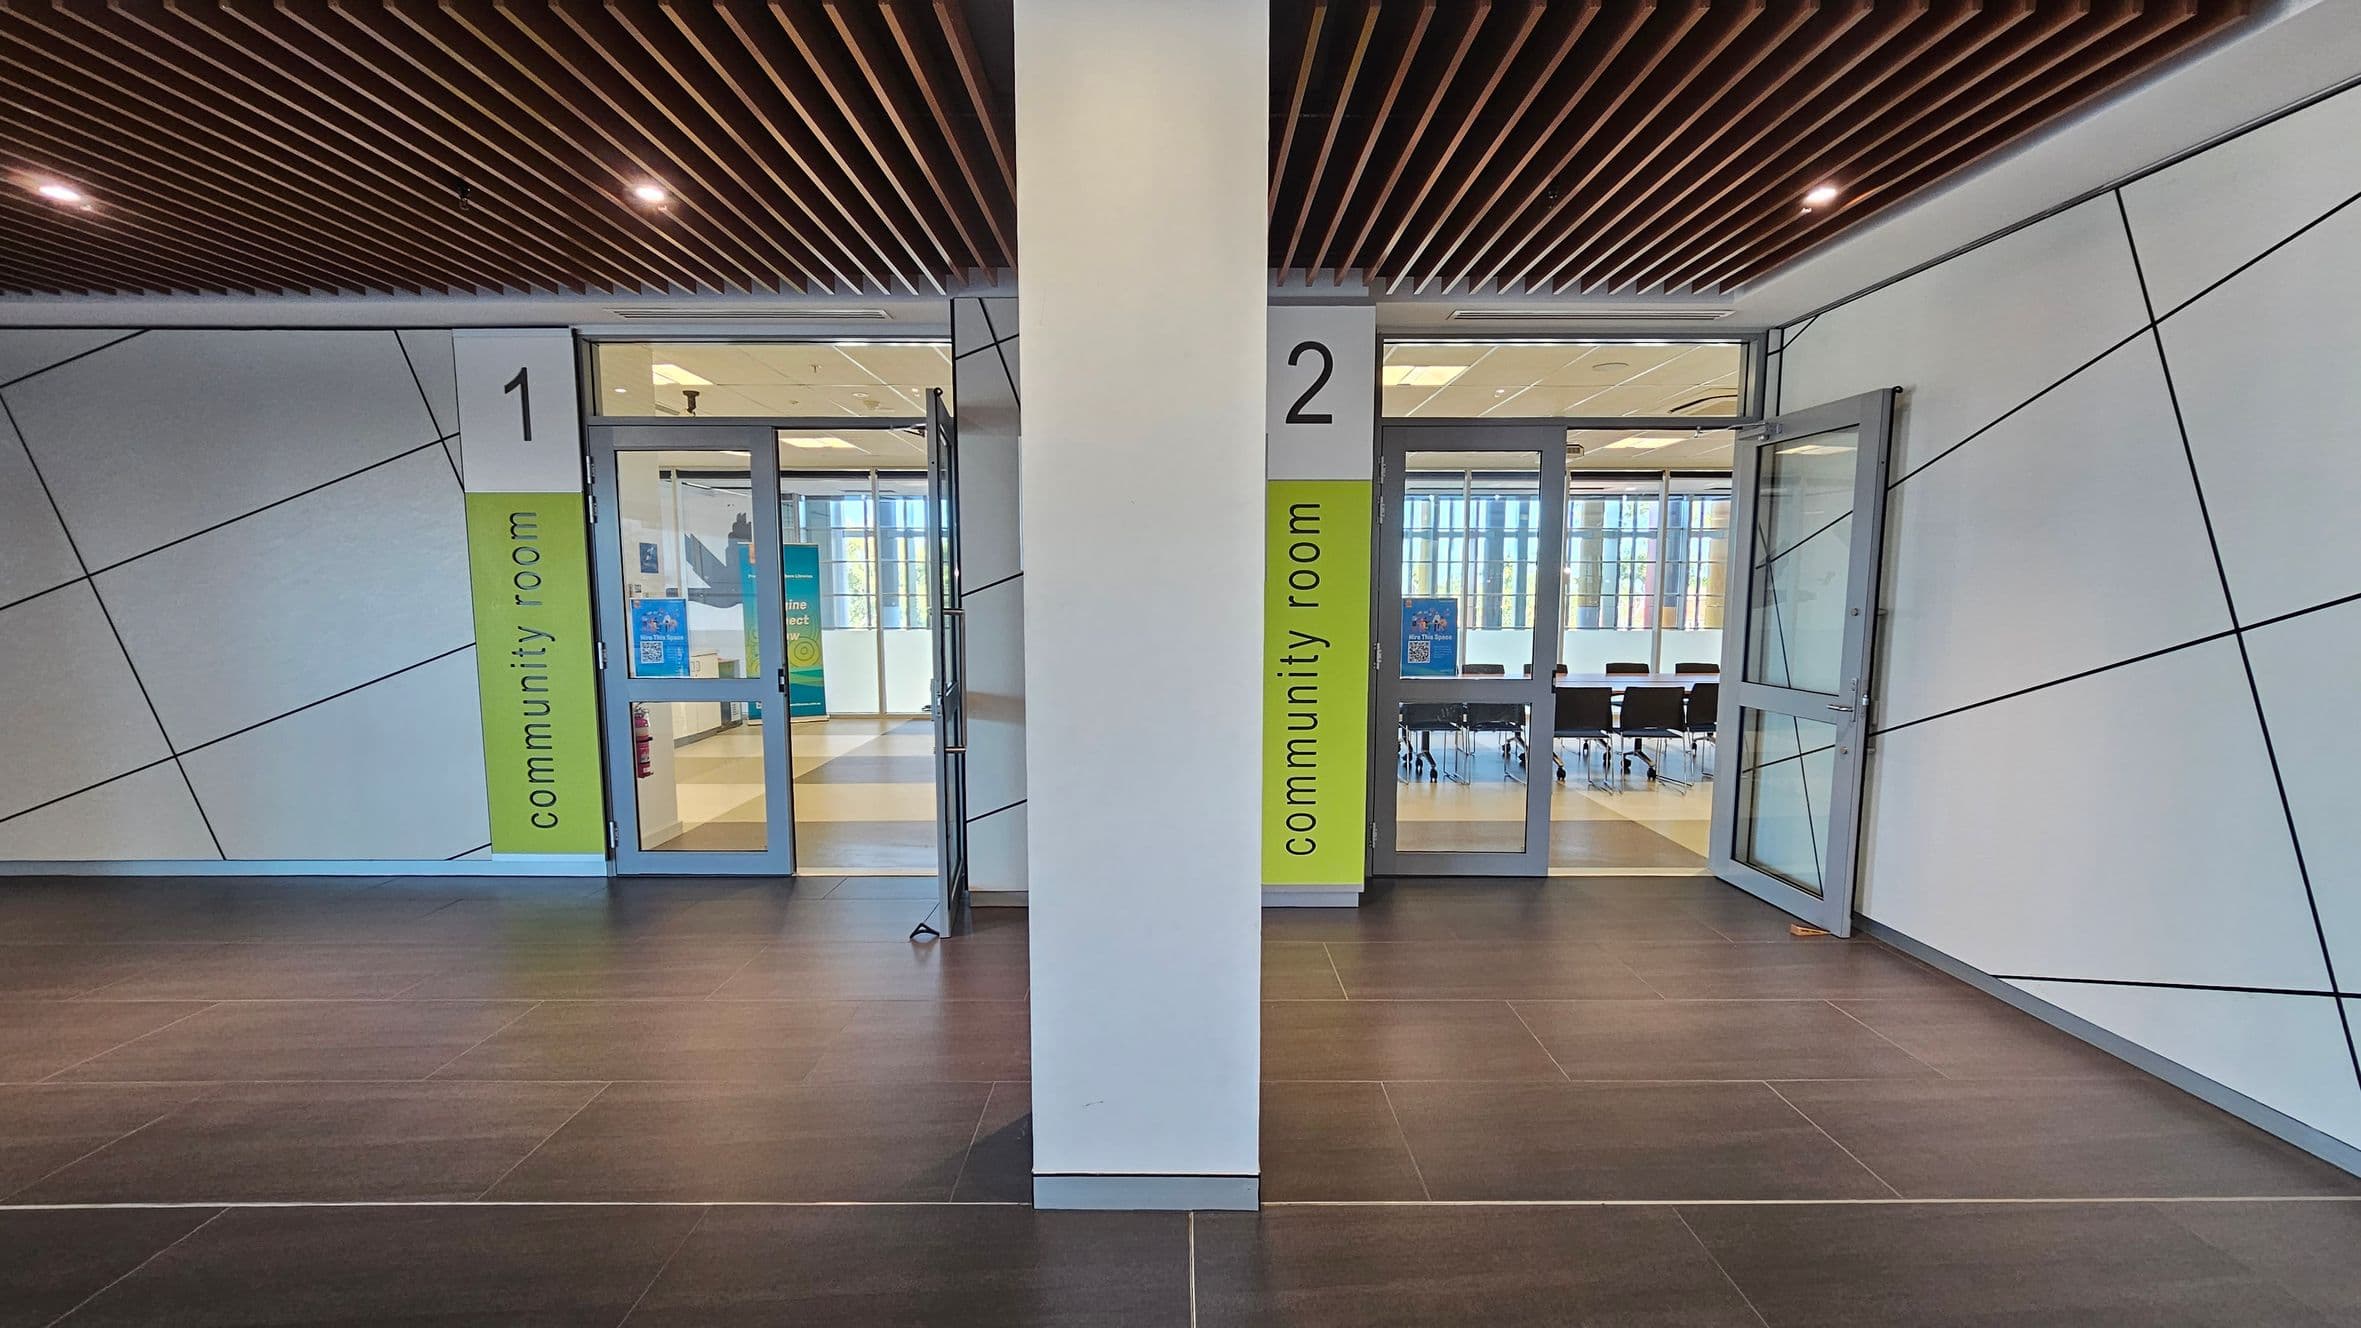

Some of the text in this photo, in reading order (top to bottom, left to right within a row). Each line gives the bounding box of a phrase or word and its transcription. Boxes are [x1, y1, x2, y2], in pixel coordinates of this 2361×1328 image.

[503, 366, 533, 442] 1
[1286, 341, 1334, 424] 2
[509, 512, 559, 829] community room
[666, 634, 683, 642] Space
[1277, 503, 1330, 856] community room
